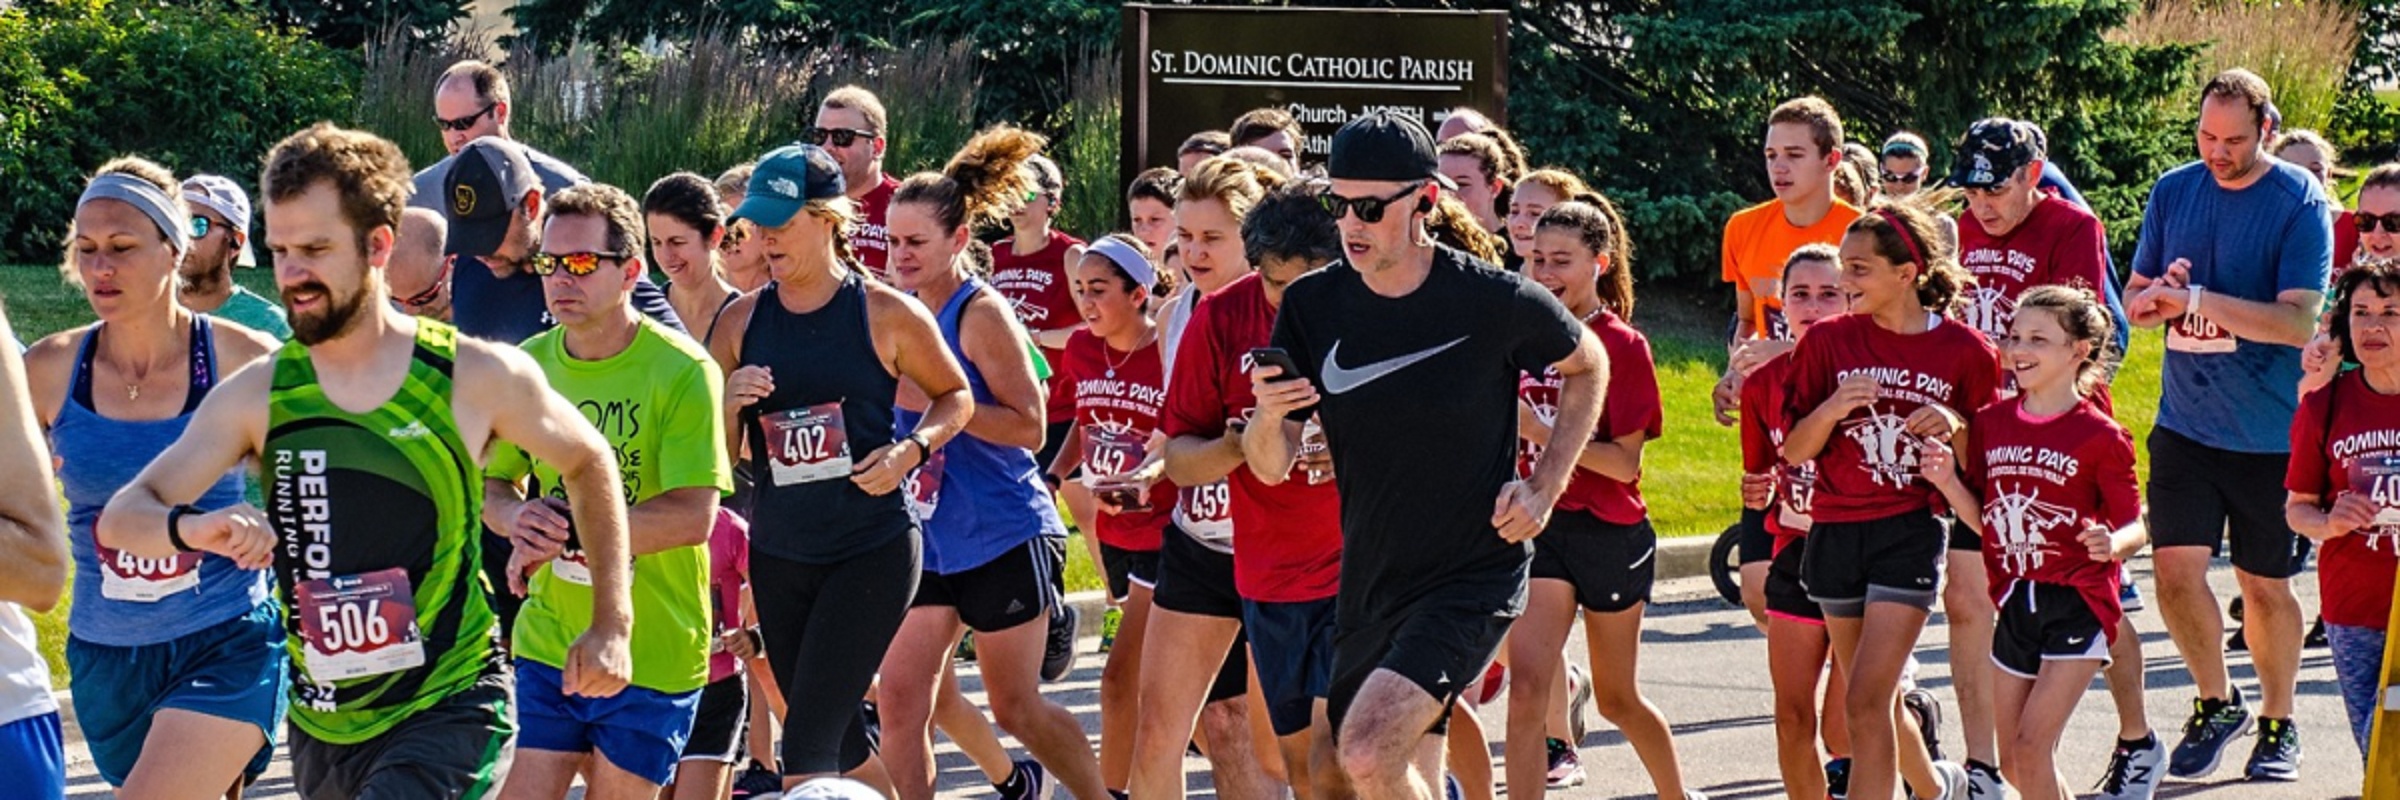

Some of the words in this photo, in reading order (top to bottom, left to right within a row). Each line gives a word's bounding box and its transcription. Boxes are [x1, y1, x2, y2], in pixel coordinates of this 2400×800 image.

[1151, 50, 1177, 73] ST.
[1184, 52, 1281, 77] DOMINIC
[1287, 54, 1394, 79] CATHOLIC
[1400, 56, 1474, 81] PARISH
[1289, 102, 1347, 122] Church
[1303, 135, 1333, 154] Athl
[784, 425, 829, 462] 402
[2037, 448, 2079, 477] DAYS
[275, 449, 300, 558] RUNNING
[1191, 483, 1230, 519] 459
[2371, 475, 2400, 506] 40
[319, 599, 389, 650] 506
